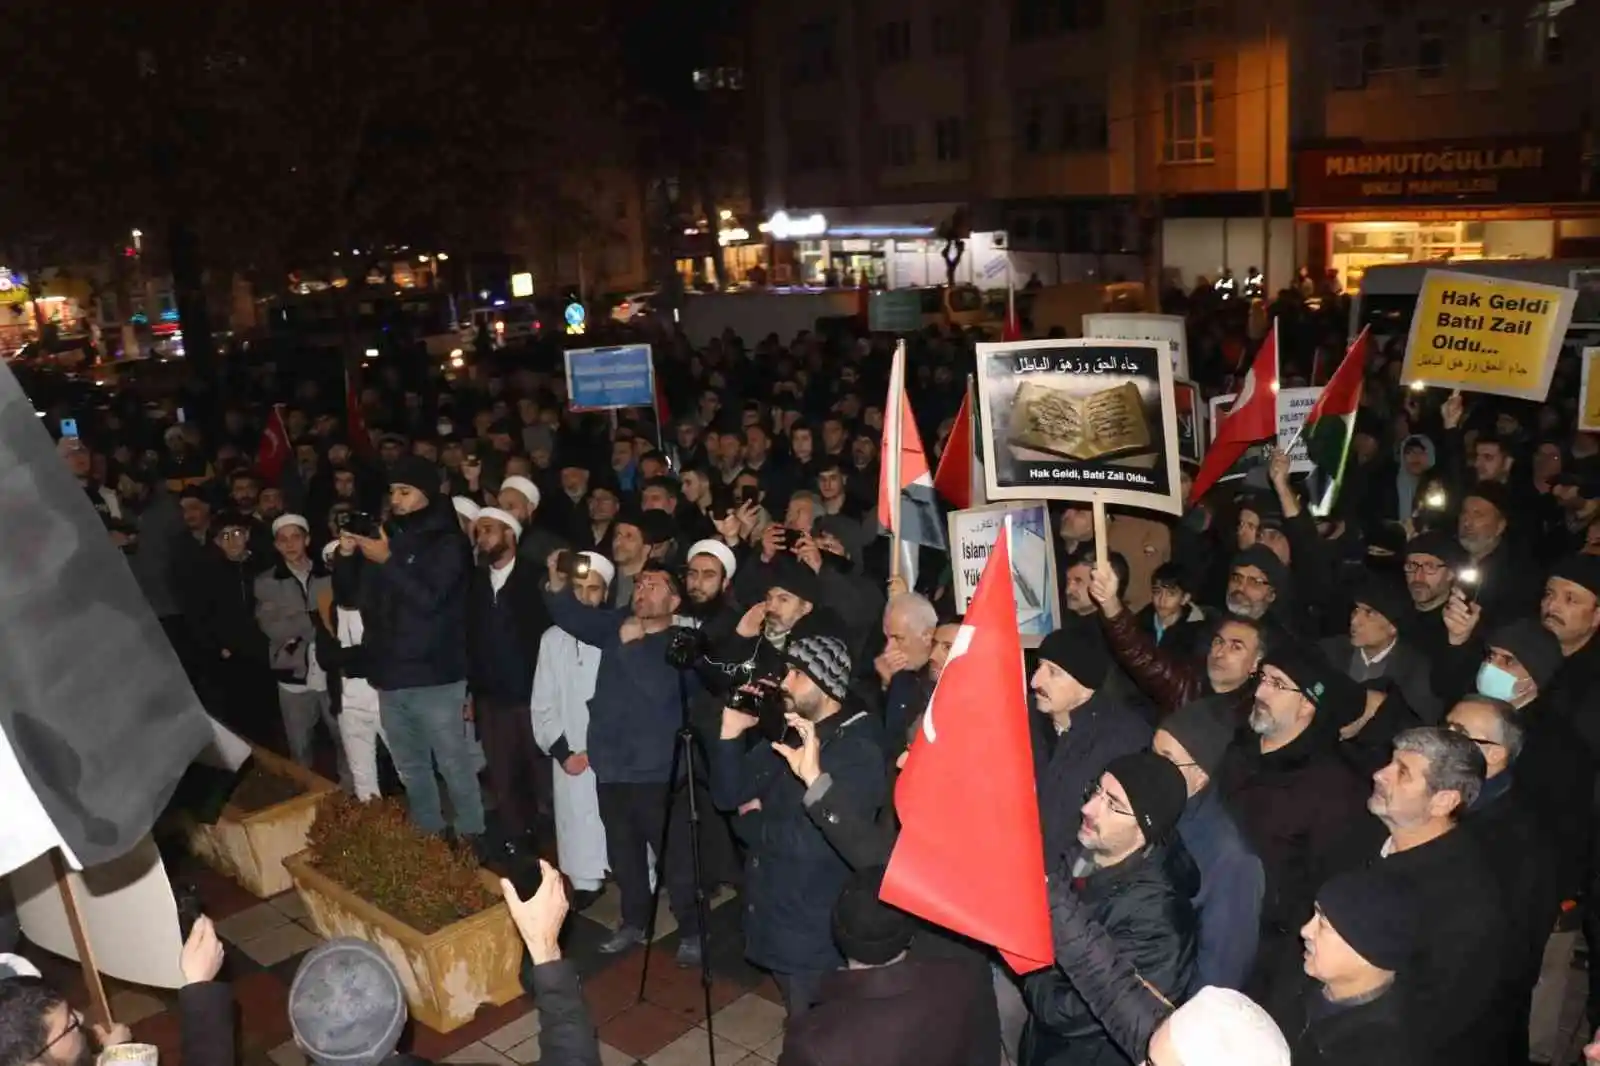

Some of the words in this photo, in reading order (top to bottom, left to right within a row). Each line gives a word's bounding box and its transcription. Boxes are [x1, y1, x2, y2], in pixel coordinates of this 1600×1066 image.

[1441, 290, 1481, 308] Hak
[1489, 294, 1549, 315] Geldi
[1437, 312, 1484, 330] Batıl
[1489, 317, 1532, 335] Zail
[1432, 334, 1499, 355] Oldu...
[1092, 355, 1117, 374] الحق
[1029, 469, 1050, 478] Hak
[1052, 469, 1081, 480] Geldi,
[1107, 471, 1124, 481] Zail
